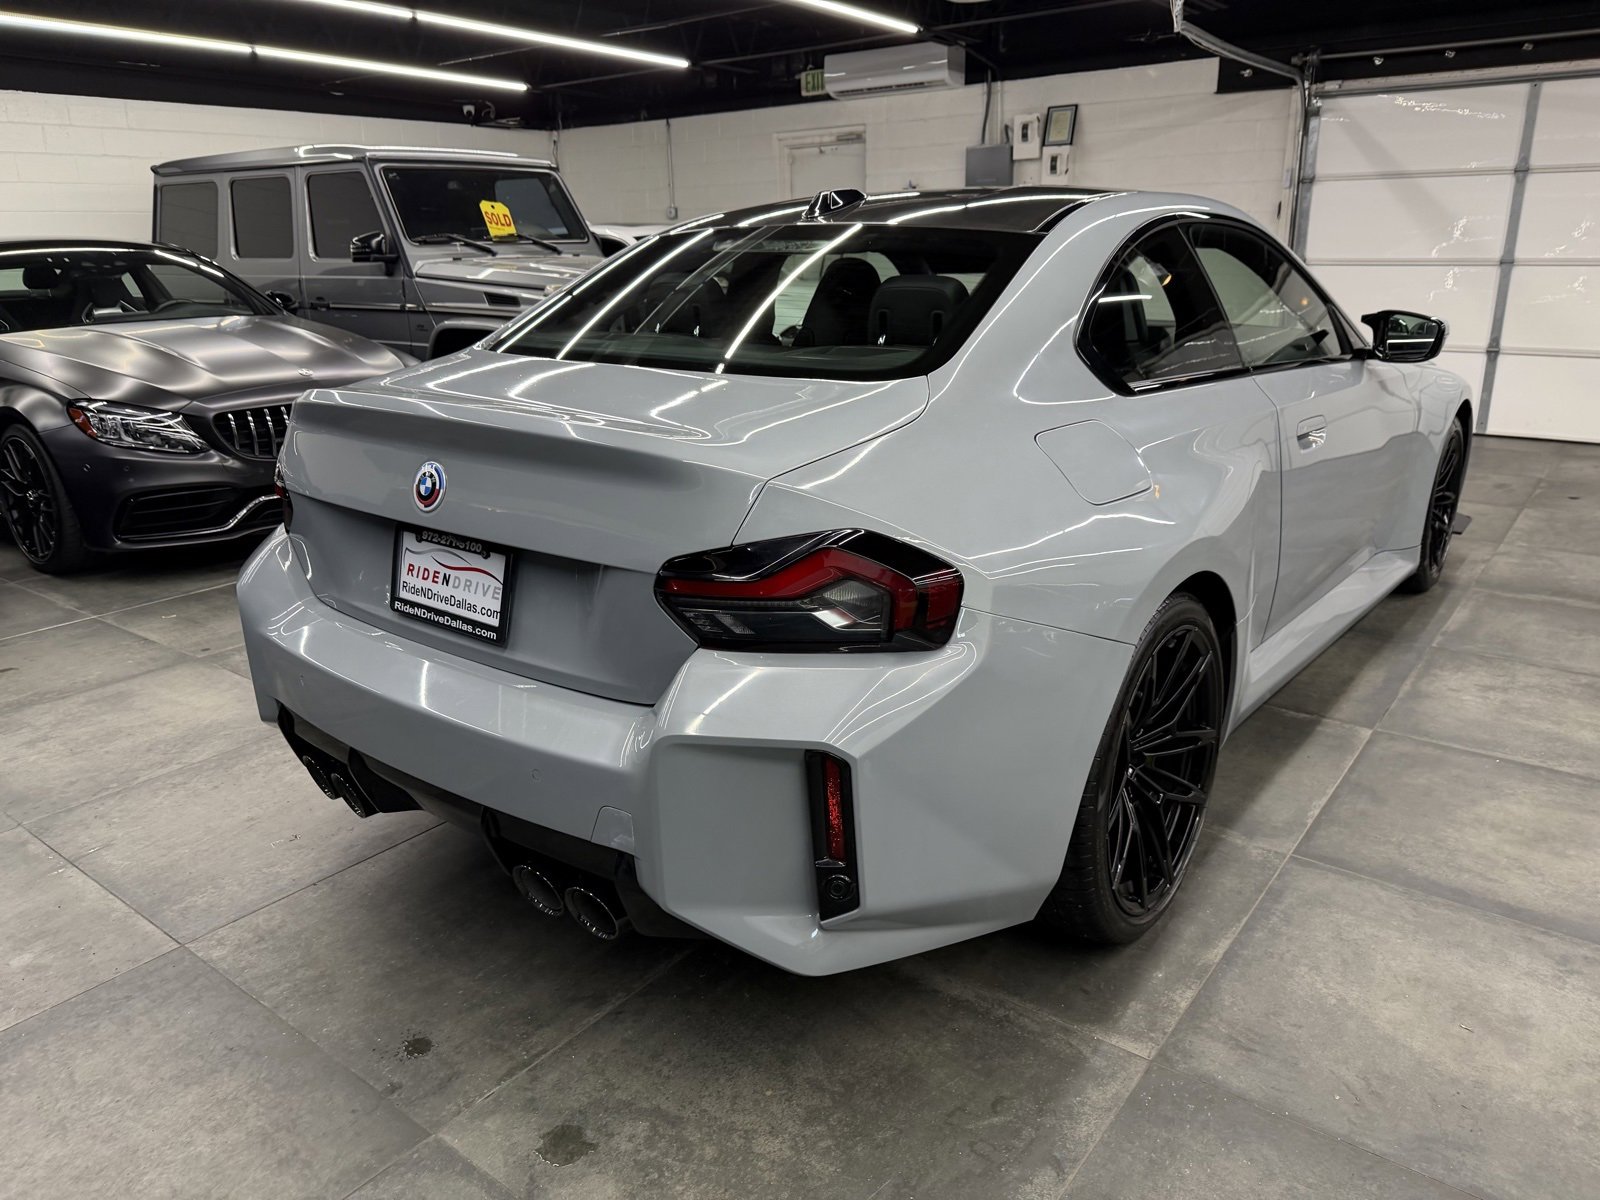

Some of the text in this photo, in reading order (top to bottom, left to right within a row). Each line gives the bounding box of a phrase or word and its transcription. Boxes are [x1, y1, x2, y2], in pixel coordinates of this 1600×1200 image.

[484, 211, 512, 227] SOLD
[394, 600, 498, 640] RideNDriveDallas.com
[401, 580, 500, 620] RideNDriveDallas.com
